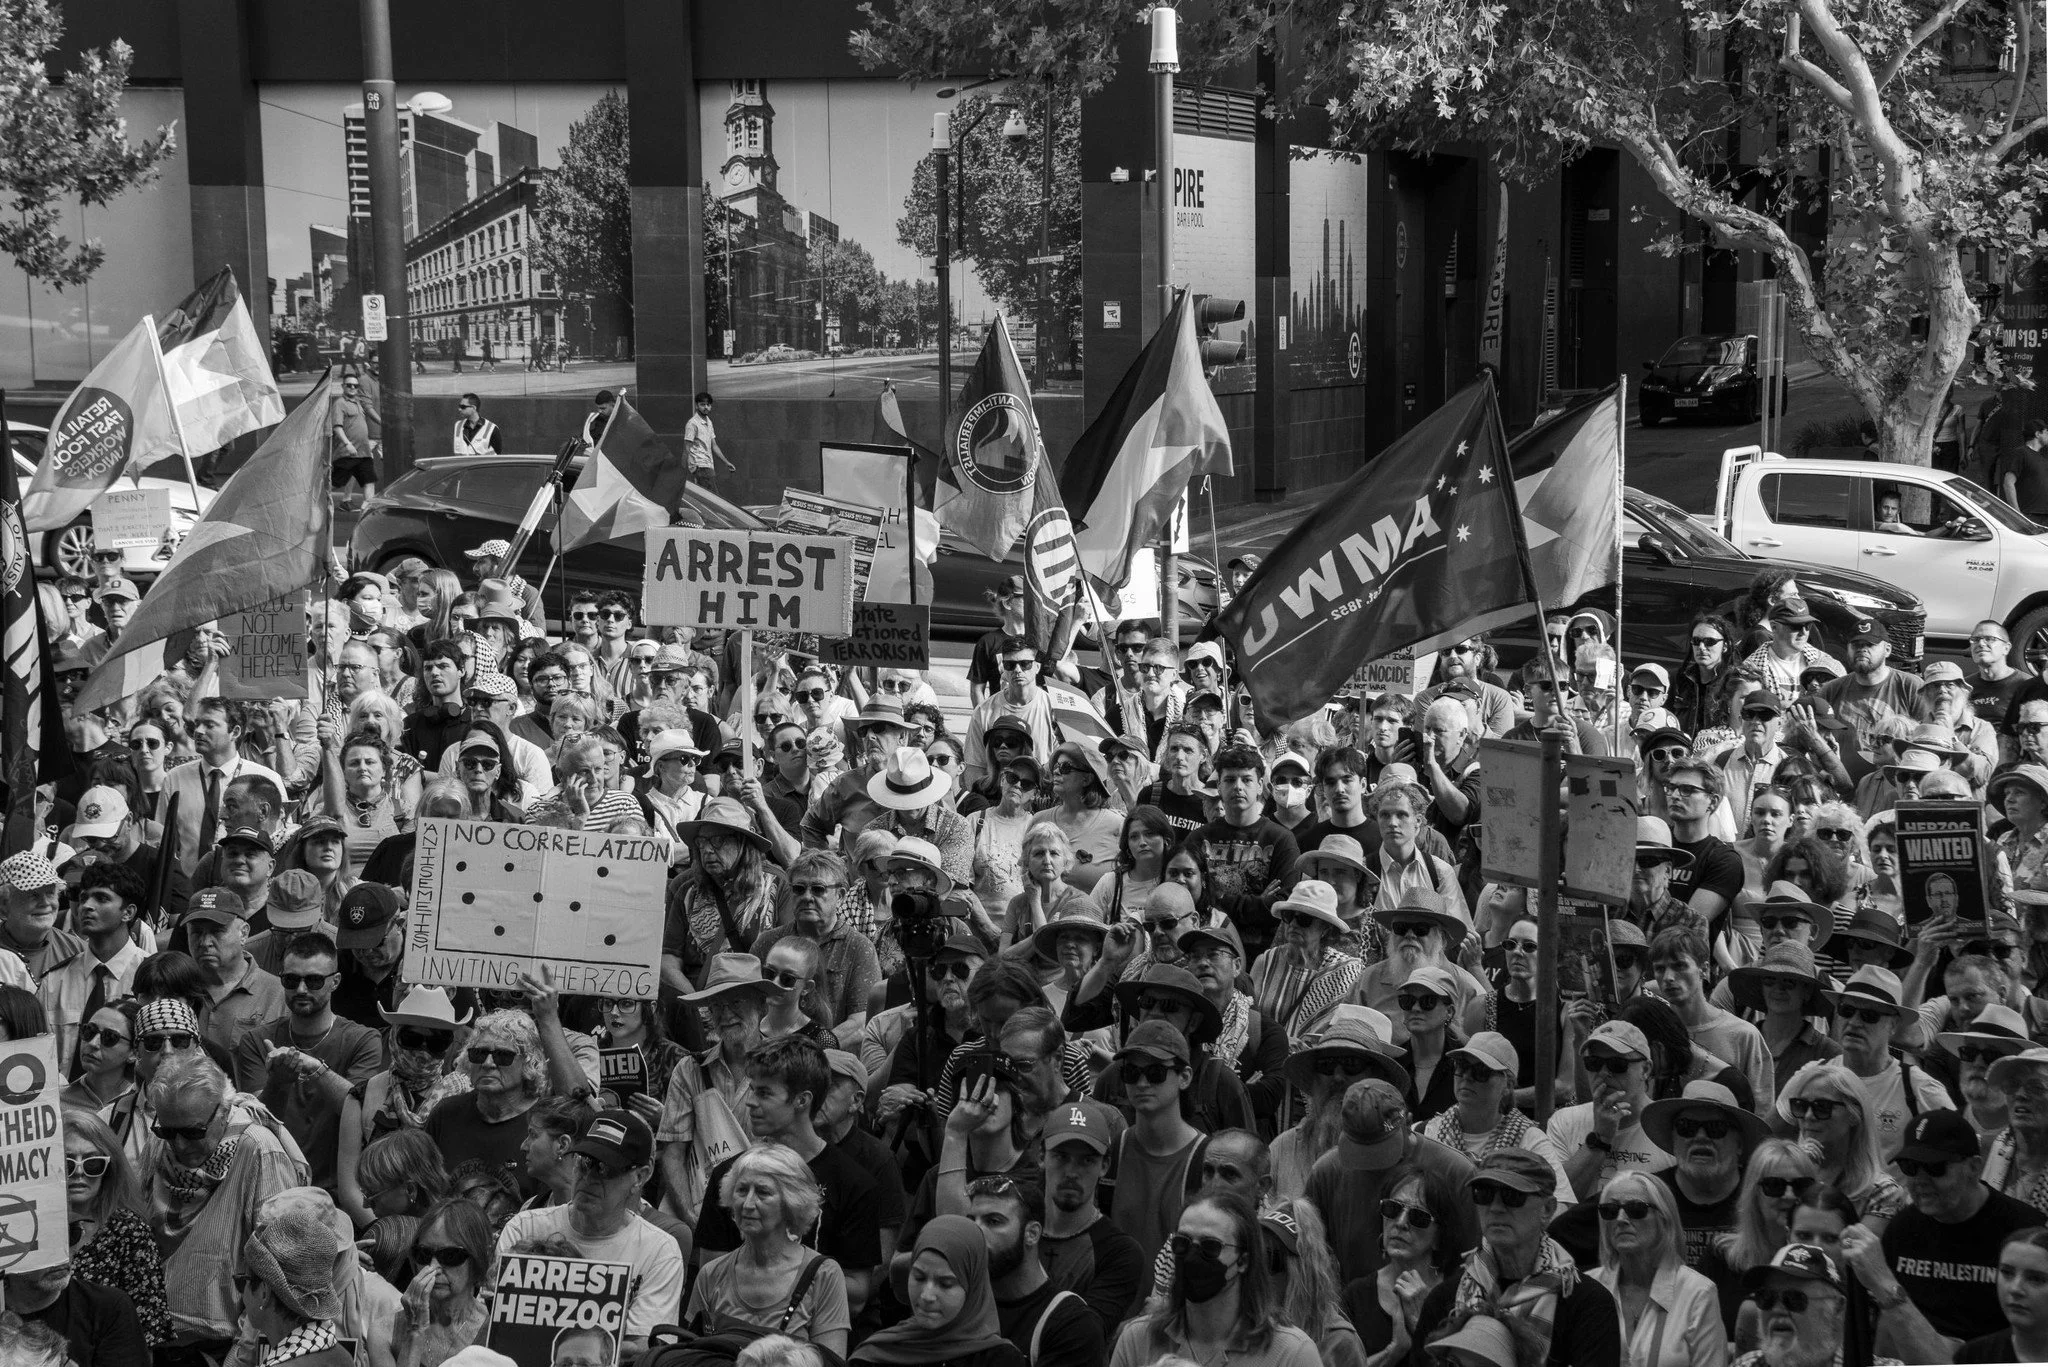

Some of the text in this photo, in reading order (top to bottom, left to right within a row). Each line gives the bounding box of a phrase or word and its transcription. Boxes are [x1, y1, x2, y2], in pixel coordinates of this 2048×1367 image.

[367, 92, 380, 101] G6
[367, 101, 380, 110] AU
[1174, 167, 1204, 208] PIRE
[2018, 304, 2048, 320] LUNC
[2018, 327, 2048, 348] $19.5
[107, 493, 146, 504] PENNY
[4, 552, 23, 591] AUST
[655, 538, 836, 591] ARREST
[698, 590, 802, 629] HIM
[242, 613, 279, 635] NOT
[853, 622, 922, 642] ctioned
[230, 633, 302, 656] WELCOME
[829, 642, 926, 664] TERRORISM
[1166, 814, 1204, 831] ALESTIN
[454, 822, 670, 863] NO CORRELATION
[1905, 837, 1973, 861] WANTED
[420, 956, 653, 997] INVITING HERZOG
[600, 1054, 640, 1076] TED
[0, 1105, 57, 1148] THEID
[1070, 1107, 1086, 1127] LA
[0, 1147, 51, 1186] MACY
[499, 1258, 628, 1297] ARREST
[1896, 1255, 1998, 1284] FREE PALESTIN
[492, 1292, 622, 1331] HERZOG
